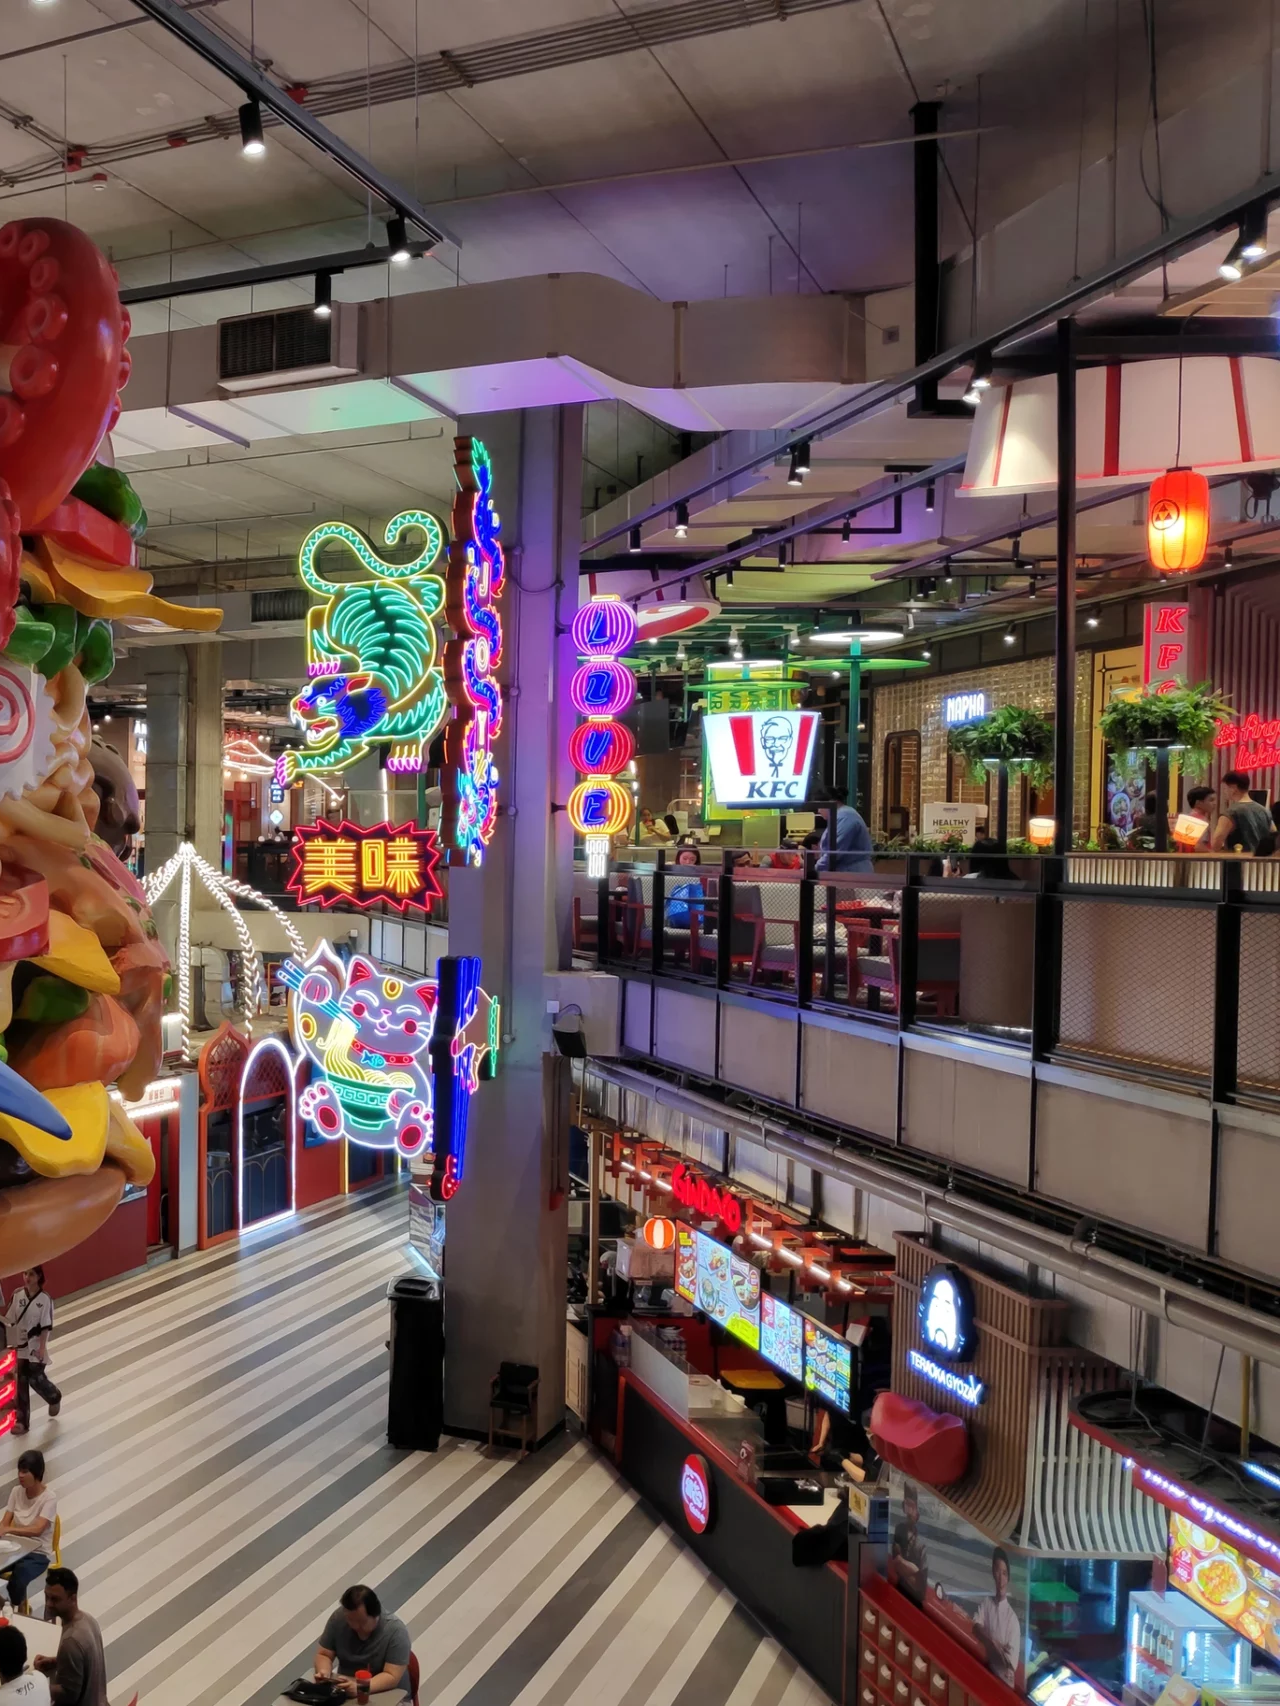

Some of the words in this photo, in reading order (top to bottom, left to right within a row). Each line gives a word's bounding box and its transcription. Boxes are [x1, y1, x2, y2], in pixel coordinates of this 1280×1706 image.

[583, 608, 614, 826] LOVE
[947, 693, 985, 722] NAPHA
[746, 781, 799, 798] KFC
[303, 837, 421, 894] 美味
[910, 1350, 946, 1386] TERAOKA
[946, 1372, 974, 1402] GYOZA
